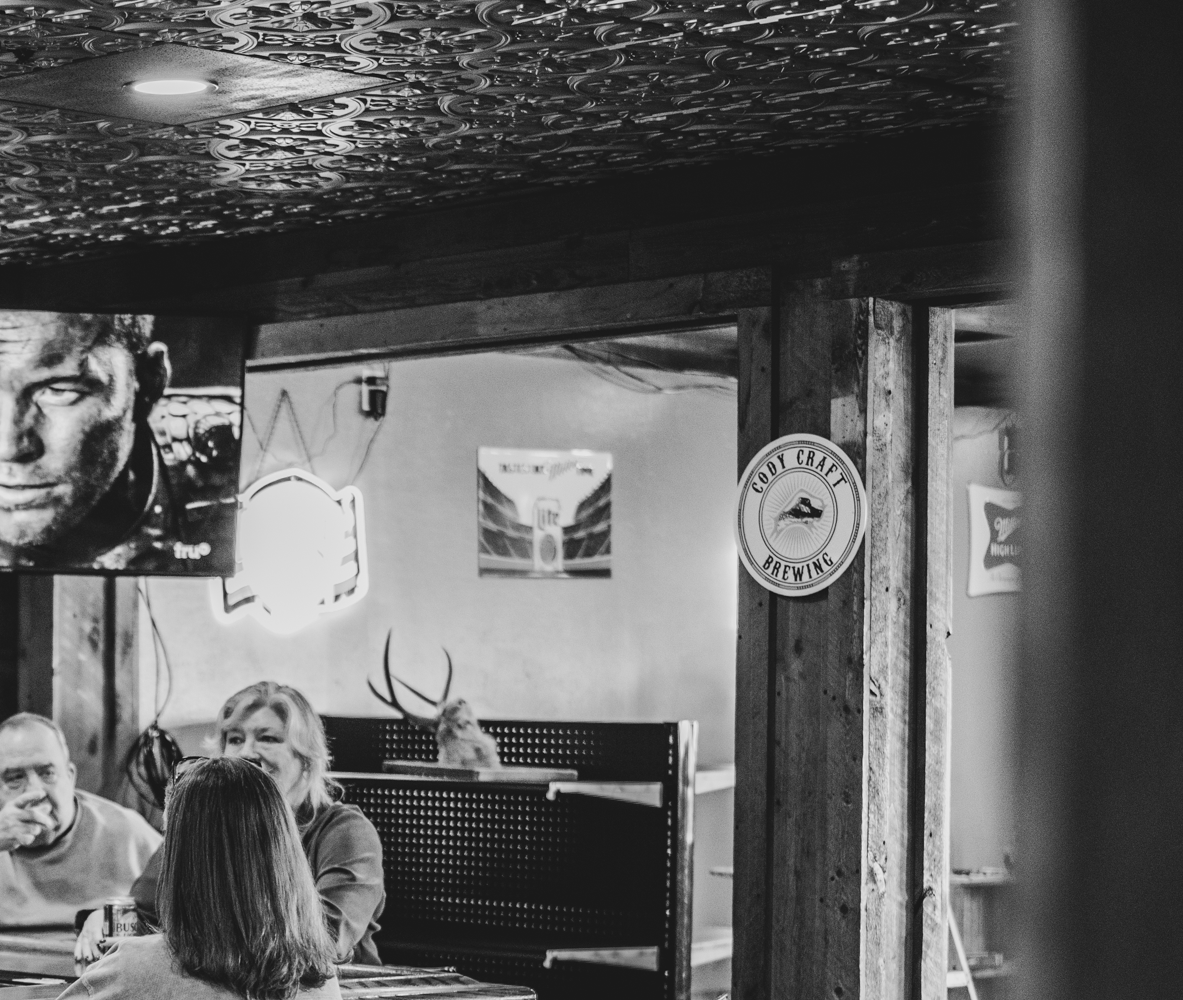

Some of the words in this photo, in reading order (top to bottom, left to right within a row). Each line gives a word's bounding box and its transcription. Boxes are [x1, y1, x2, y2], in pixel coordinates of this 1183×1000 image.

[751, 452, 786, 494] CODY
[796, 449, 848, 489] CRAFT
[762, 552, 834, 582] BREWING
